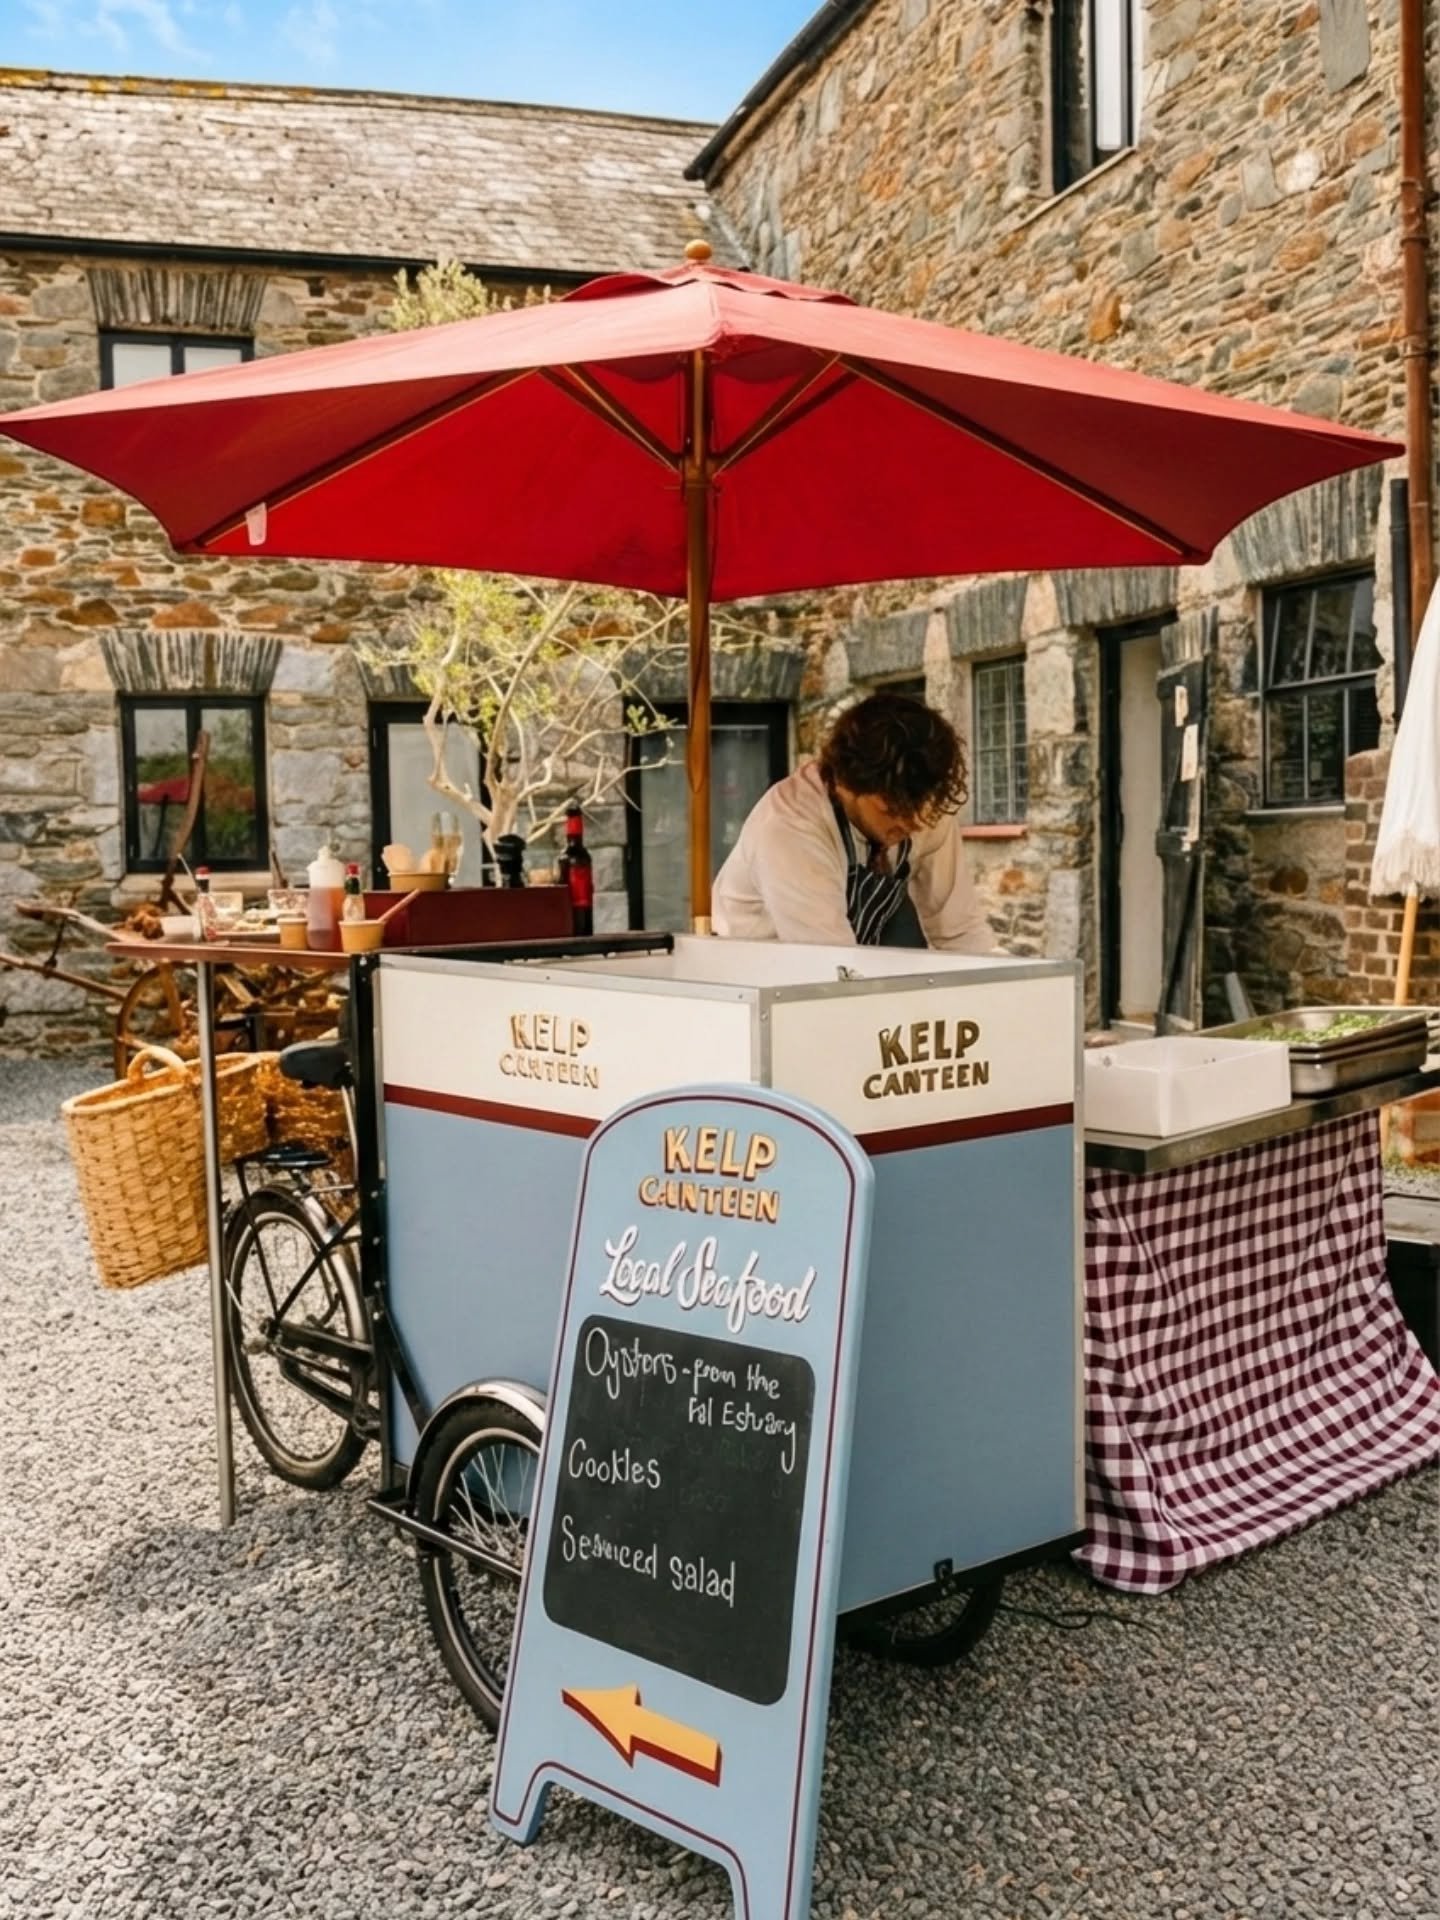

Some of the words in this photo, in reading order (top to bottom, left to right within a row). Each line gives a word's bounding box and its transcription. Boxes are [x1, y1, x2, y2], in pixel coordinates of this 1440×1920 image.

[510, 1013, 590, 1057] KELP
[879, 1020, 980, 1069] KELP
[863, 1061, 989, 1099] CANTEEN
[664, 1126, 777, 1182] KELP
[599, 1225, 688, 1306] Local
[677, 1236, 818, 1334] Seafood
[746, 1363, 781, 1400] the
[721, 1401, 796, 1474] Estuary
